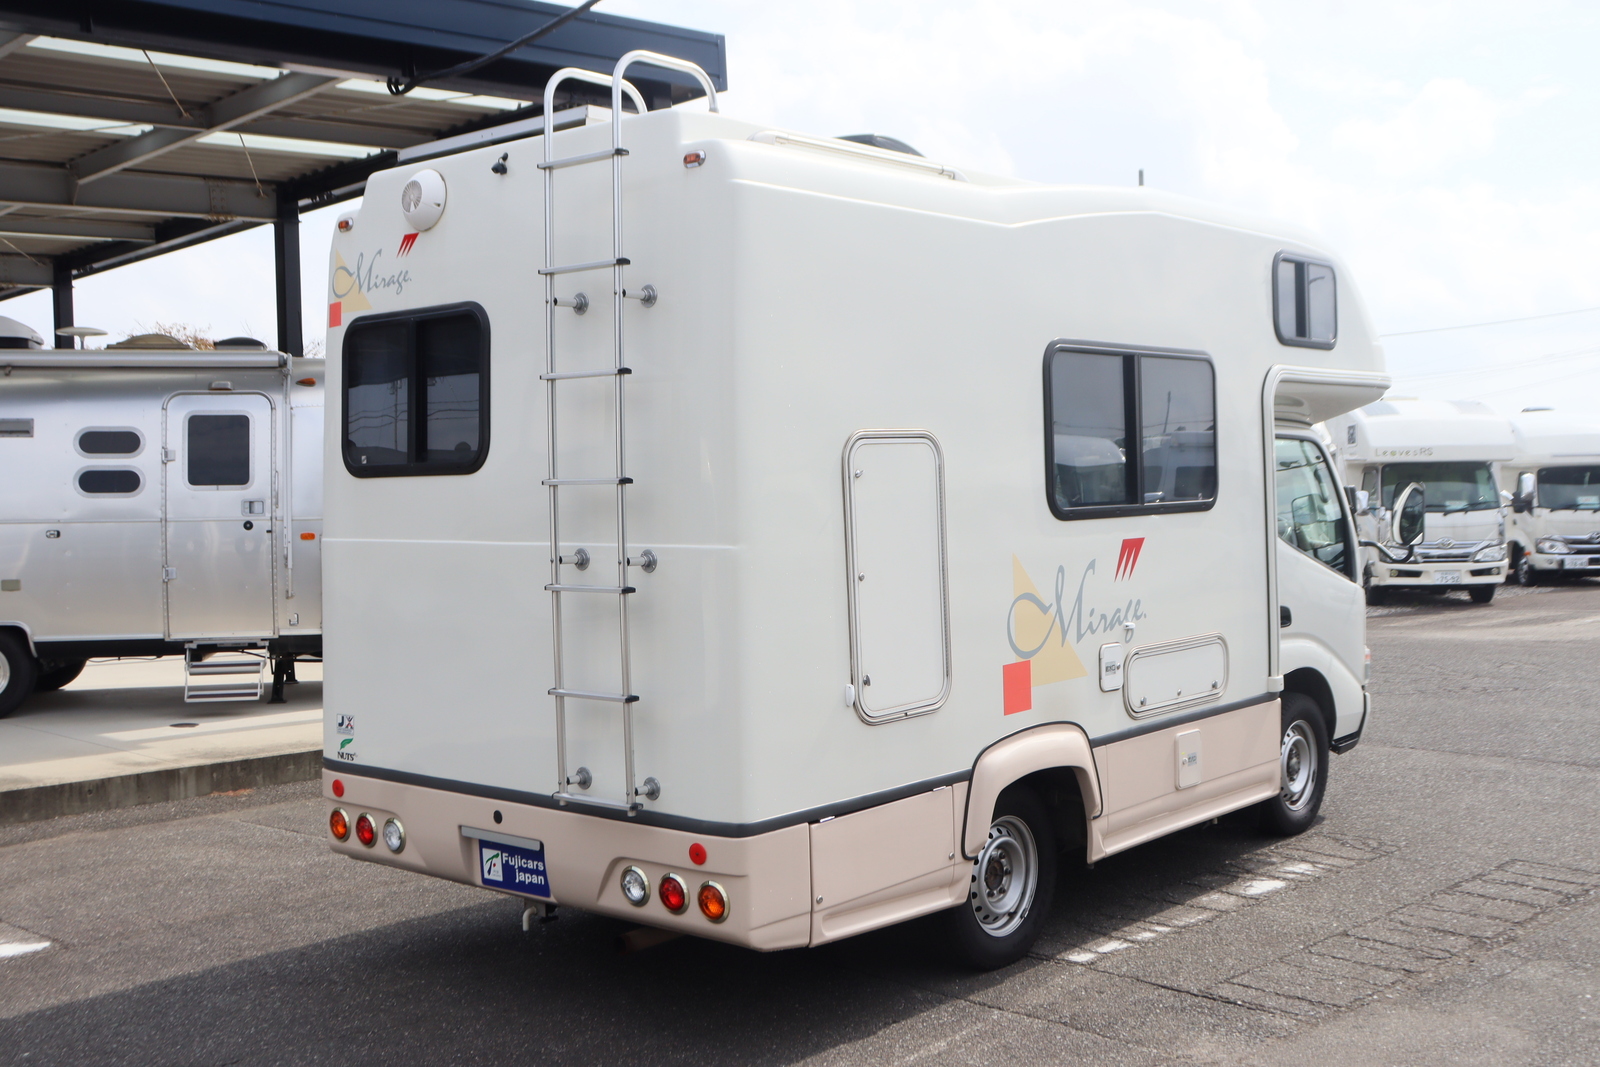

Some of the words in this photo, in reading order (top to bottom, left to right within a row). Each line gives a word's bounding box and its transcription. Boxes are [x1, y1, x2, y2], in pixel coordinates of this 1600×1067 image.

[337, 751, 355, 761] NUTS
[502, 852, 544, 871] Fujicars
[515, 868, 545, 885] japan
